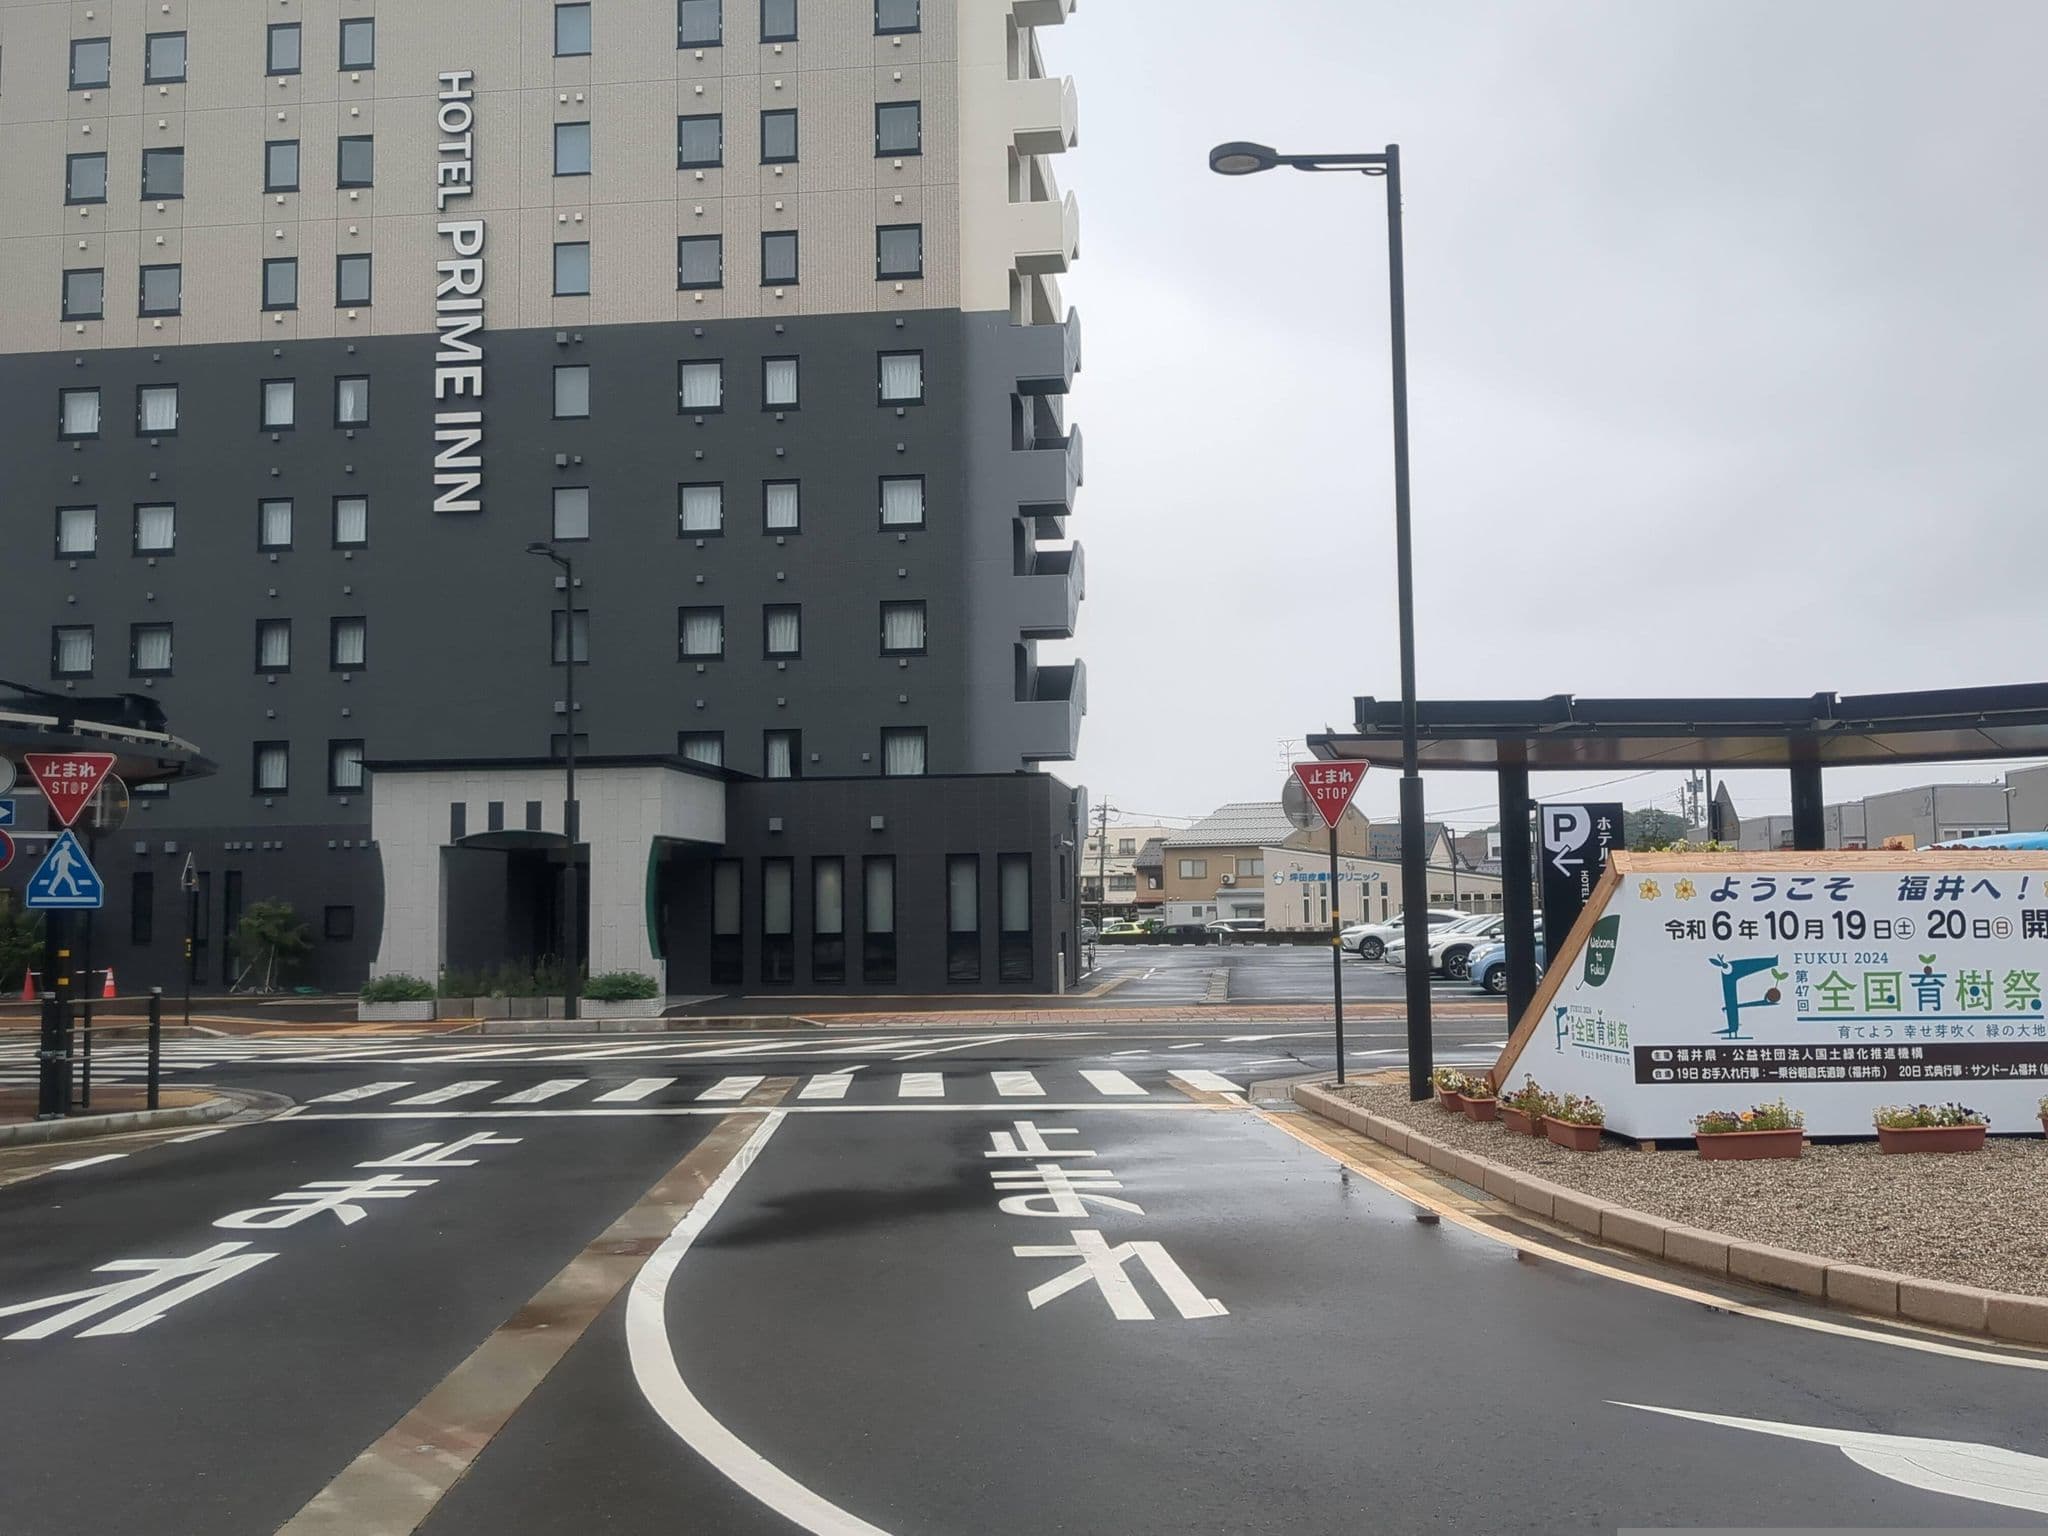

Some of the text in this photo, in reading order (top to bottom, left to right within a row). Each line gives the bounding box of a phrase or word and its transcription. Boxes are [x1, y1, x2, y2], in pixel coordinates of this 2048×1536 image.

[433, 69, 485, 512] HOTEL PRIME INN
[42, 761, 97, 778] 止まれ
[1308, 768, 1354, 785] 止まれ
[52, 782, 89, 795] STOP
[1316, 787, 1348, 800] STOP
[1580, 870, 1590, 898] HOTEL
[1710, 876, 1854, 902] ようこそ
[1590, 936, 1615, 949] Welcome
[1595, 951, 1603, 962] to
[1794, 952, 1889, 965] FUKUI 2024
[1590, 962, 1606, 976] Fukui
[1813, 968, 2042, 1013] 全国育樹祭
[1837, 1025, 1895, 1040] 育てよう
[1903, 1023, 1976, 1039] 幸せ芽吹く
[983, 1120, 1230, 1320] 止まれ
[0, 1131, 524, 1340] 止まれ
